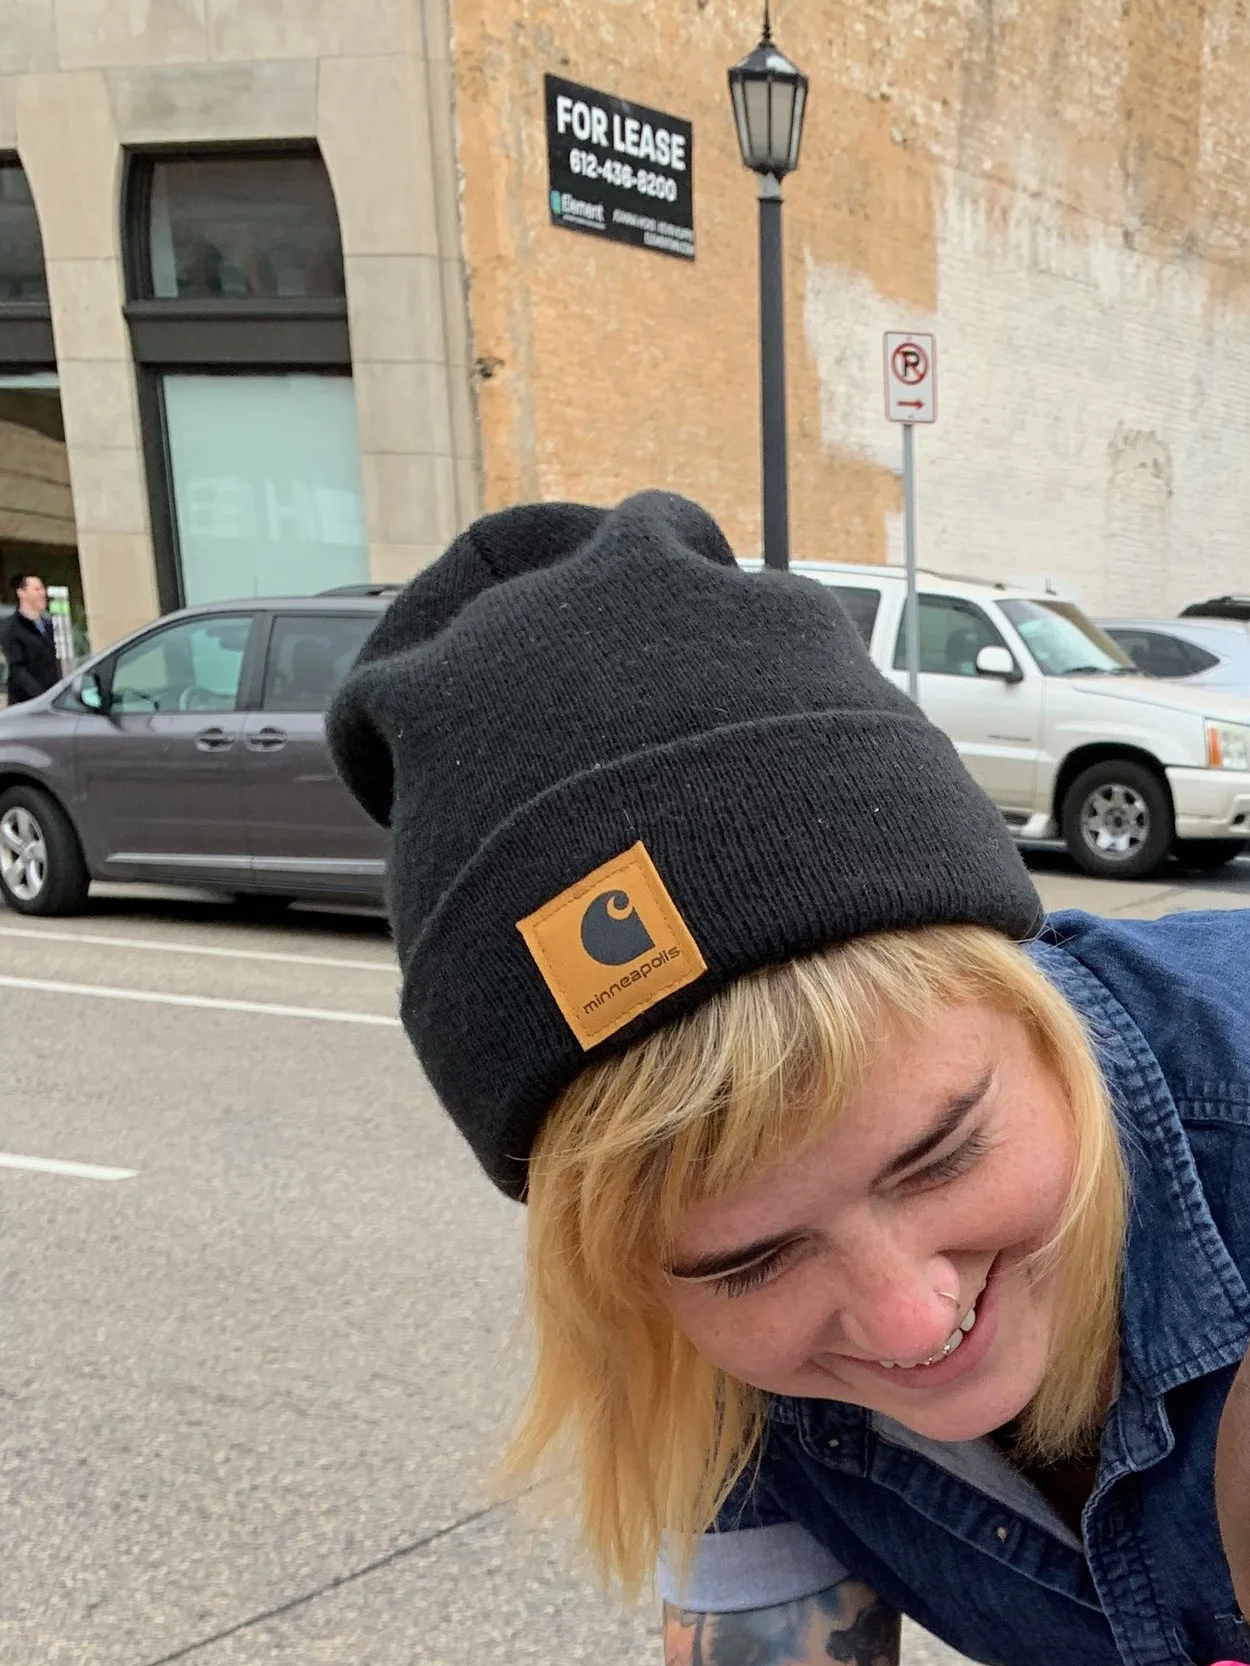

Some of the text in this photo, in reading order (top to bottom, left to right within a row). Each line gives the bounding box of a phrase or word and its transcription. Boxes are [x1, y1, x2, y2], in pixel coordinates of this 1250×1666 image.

[556, 95, 686, 171] FOR LEASE
[582, 946, 681, 1015] minneapolis
